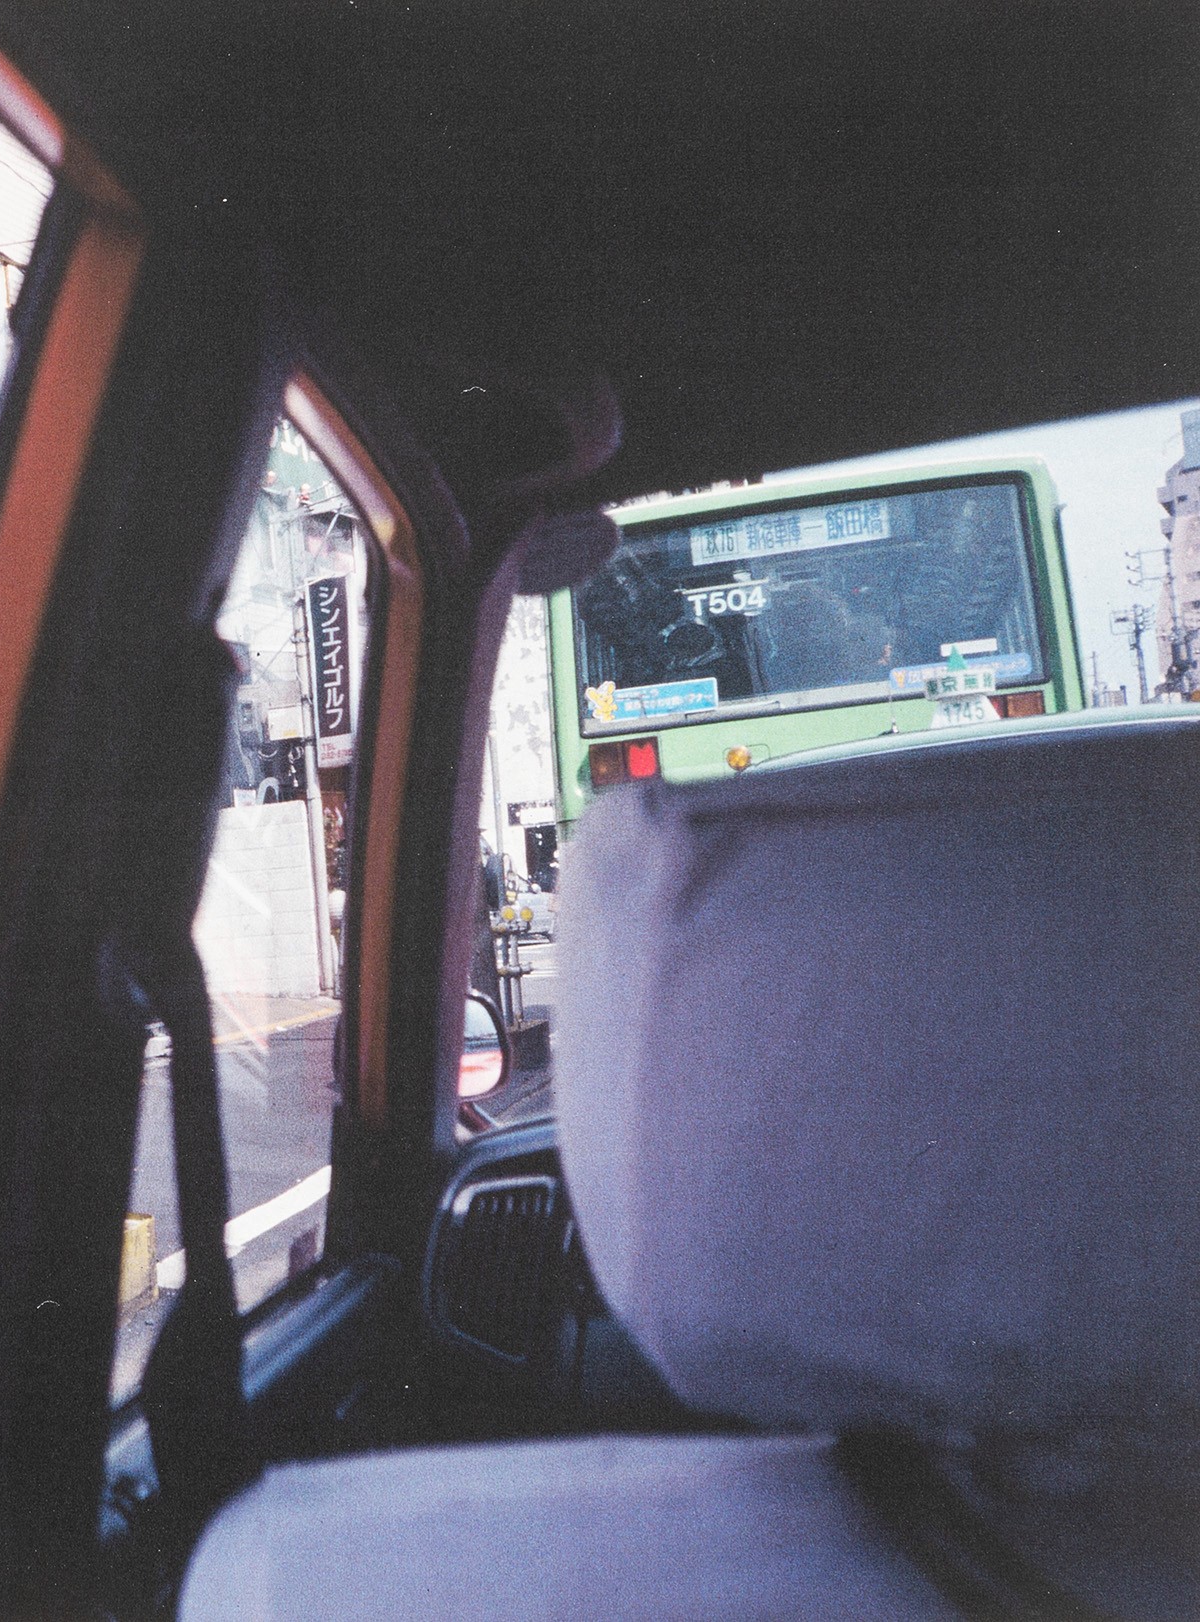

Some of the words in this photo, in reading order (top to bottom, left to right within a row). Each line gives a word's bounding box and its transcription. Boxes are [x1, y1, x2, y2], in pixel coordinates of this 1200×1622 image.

[688, 583, 767, 617] T504
[319, 586, 345, 730] シンエイゴルフ
[943, 701, 985, 722] 1745
